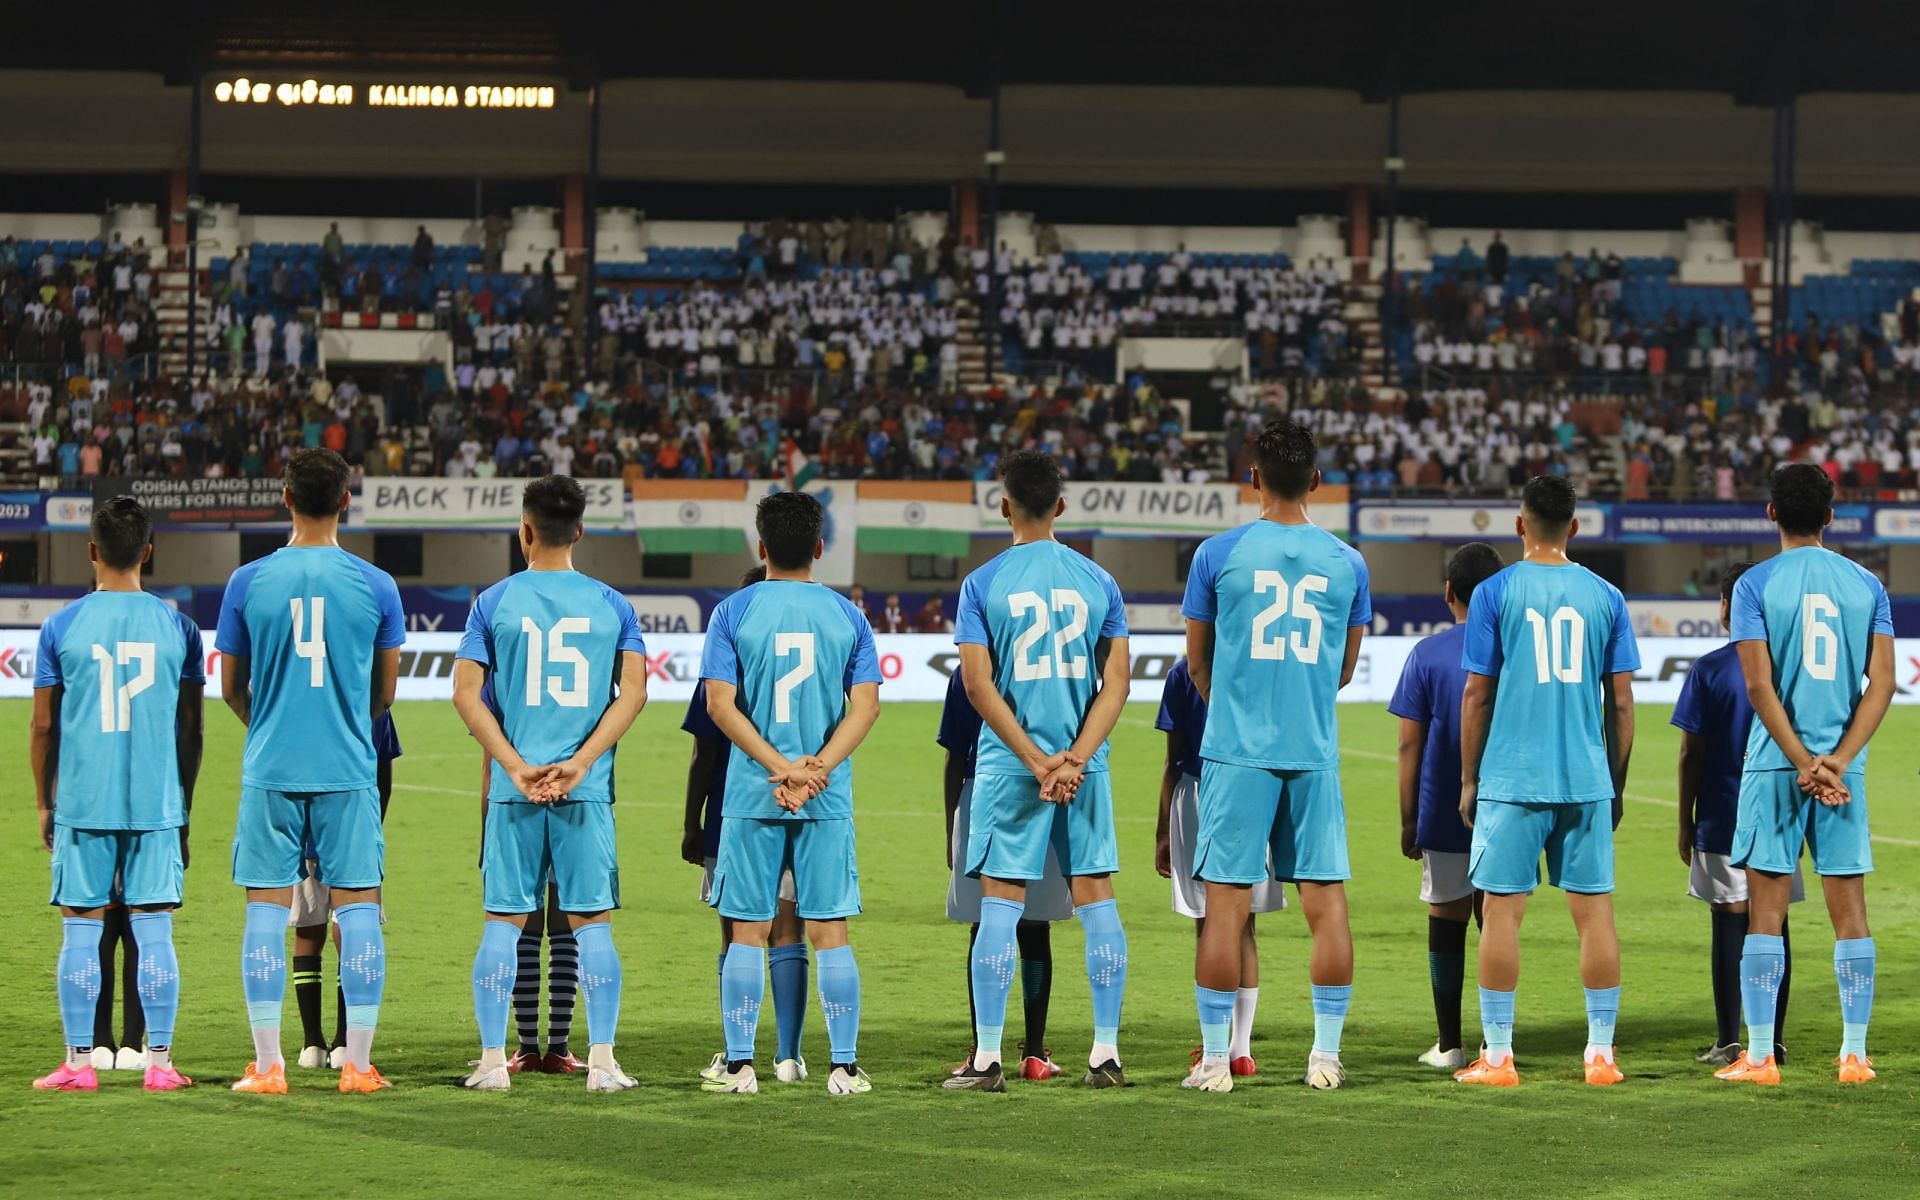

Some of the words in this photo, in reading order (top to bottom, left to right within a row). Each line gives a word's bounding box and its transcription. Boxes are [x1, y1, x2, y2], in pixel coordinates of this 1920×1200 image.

[369, 85, 458, 106] KALINGA
[464, 86, 555, 107] STADIUM
[131, 480, 189, 493] ODISHA
[192, 478, 249, 492] STANDS
[252, 477, 289, 491] STRO
[186, 494, 215, 507] FOR
[219, 493, 248, 506] THE
[375, 485, 448, 509] BACK
[463, 485, 514, 510] THE
[1081, 488, 1129, 512] ON
[1138, 490, 1224, 519] INDIA
[1621, 518, 1660, 532] HERO
[290, 597, 326, 688] 4
[1007, 588, 1088, 682] 22
[1251, 570, 1329, 665] 25
[1525, 606, 1585, 684] 10
[1802, 594, 1839, 681] 6
[91, 641, 156, 732] 17
[521, 616, 591, 708] 15
[774, 632, 815, 723] 7
